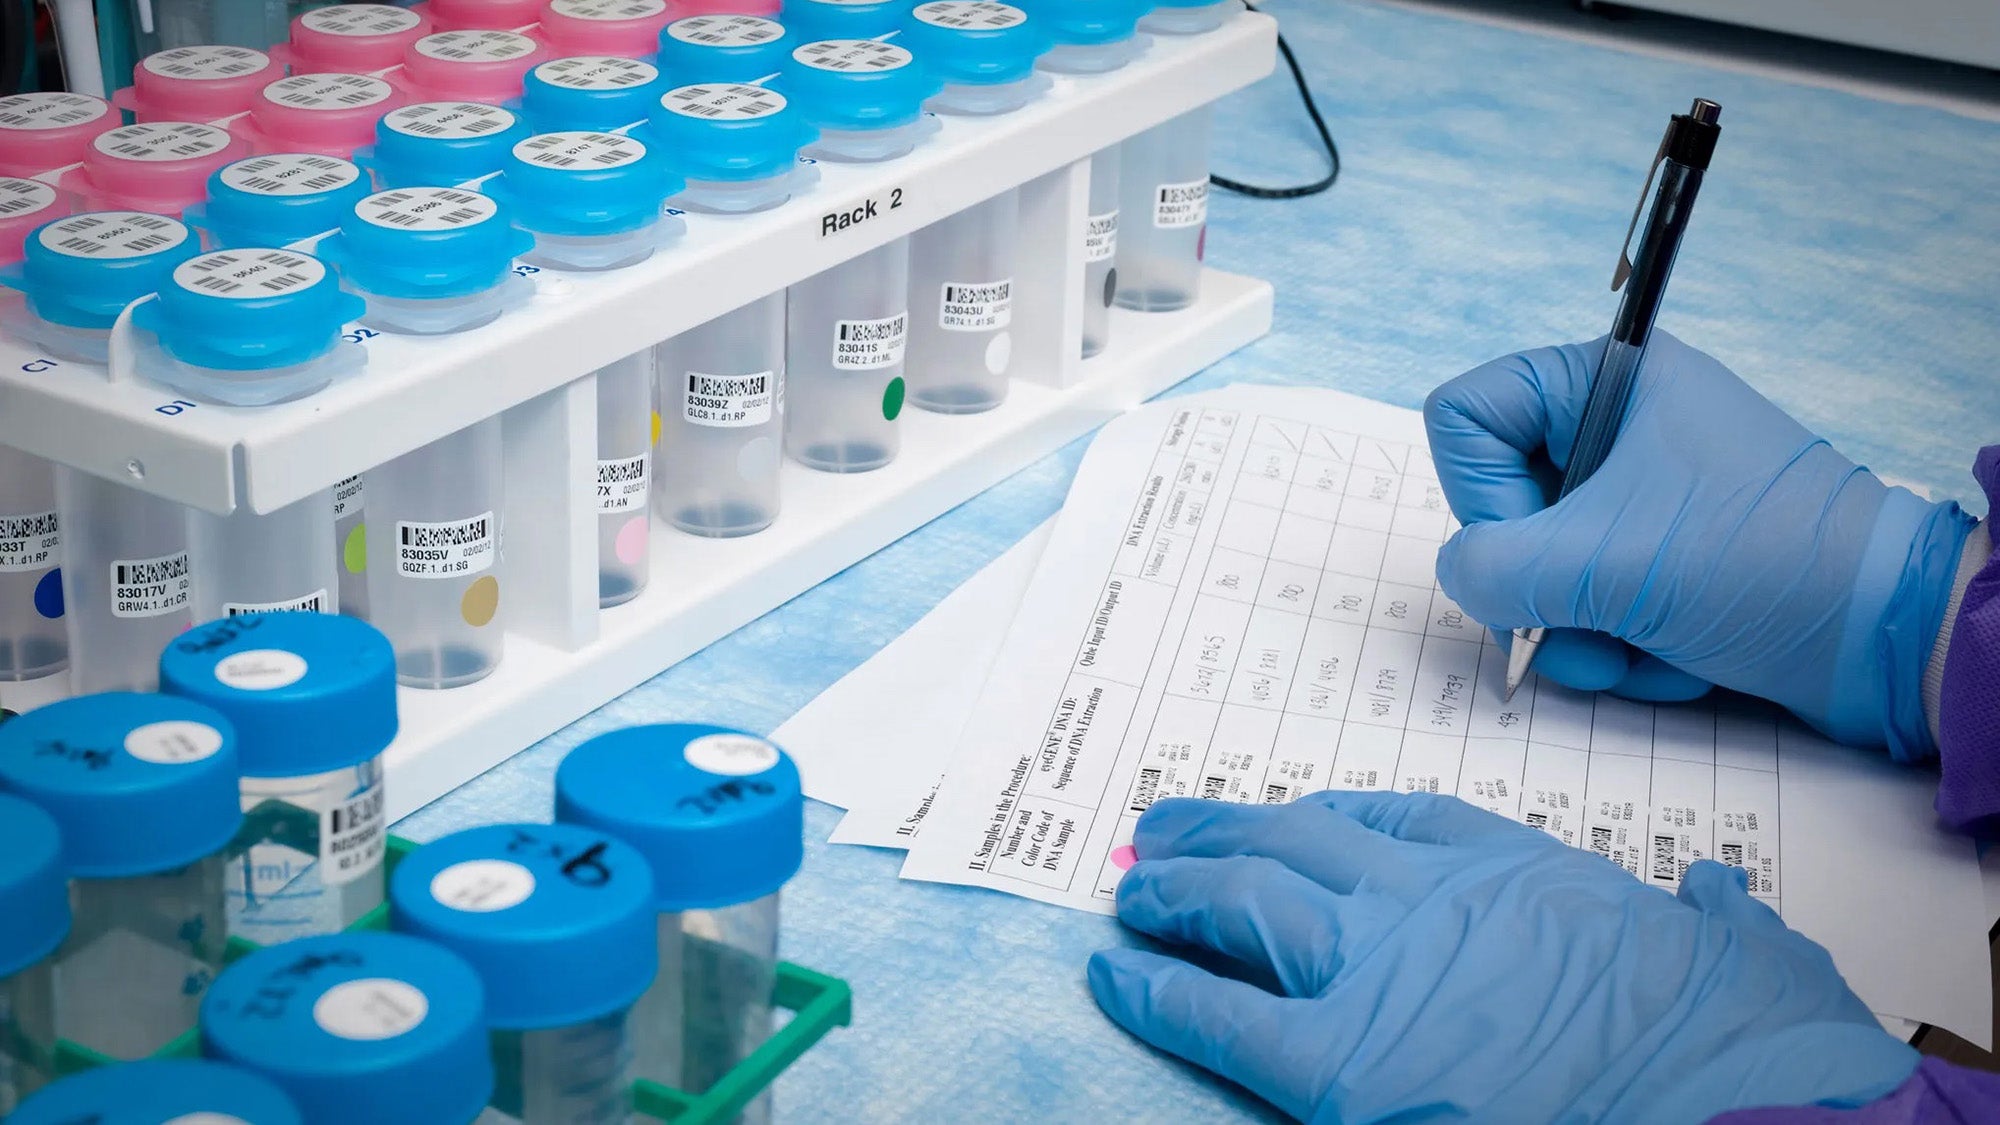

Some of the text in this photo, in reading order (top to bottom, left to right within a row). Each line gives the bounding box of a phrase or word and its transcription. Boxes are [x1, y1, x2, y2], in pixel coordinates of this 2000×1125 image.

[823, 188, 903, 237] Rack 2
[944, 305, 983, 315] 83043U
[838, 343, 878, 352] 83041S
[22, 359, 59, 373] C1
[155, 400, 197, 416] D1
[688, 396, 729, 409] 83039Z
[1126, 475, 1164, 547] DNA Extraction Results
[0, 541, 26, 553] 33T
[401, 549, 449, 561] 83035V
[117, 584, 167, 599] 83017V
[1109, 580, 1123, 591] ID
[1087, 626, 1106, 647] Input
[1079, 646, 1098, 667] Qube
[1061, 697, 1078, 711] ID:
[1053, 711, 1073, 731] DNA
[1052, 687, 1103, 791] Sequence of DNA Extraction
[969, 754, 1033, 871] II. Samples in the Procedure:
[896, 825, 915, 836] II.
[1000, 809, 1033, 860] Number and
[1021, 810, 1055, 867] Color Code of
[1043, 818, 1076, 872] DNA Sample
